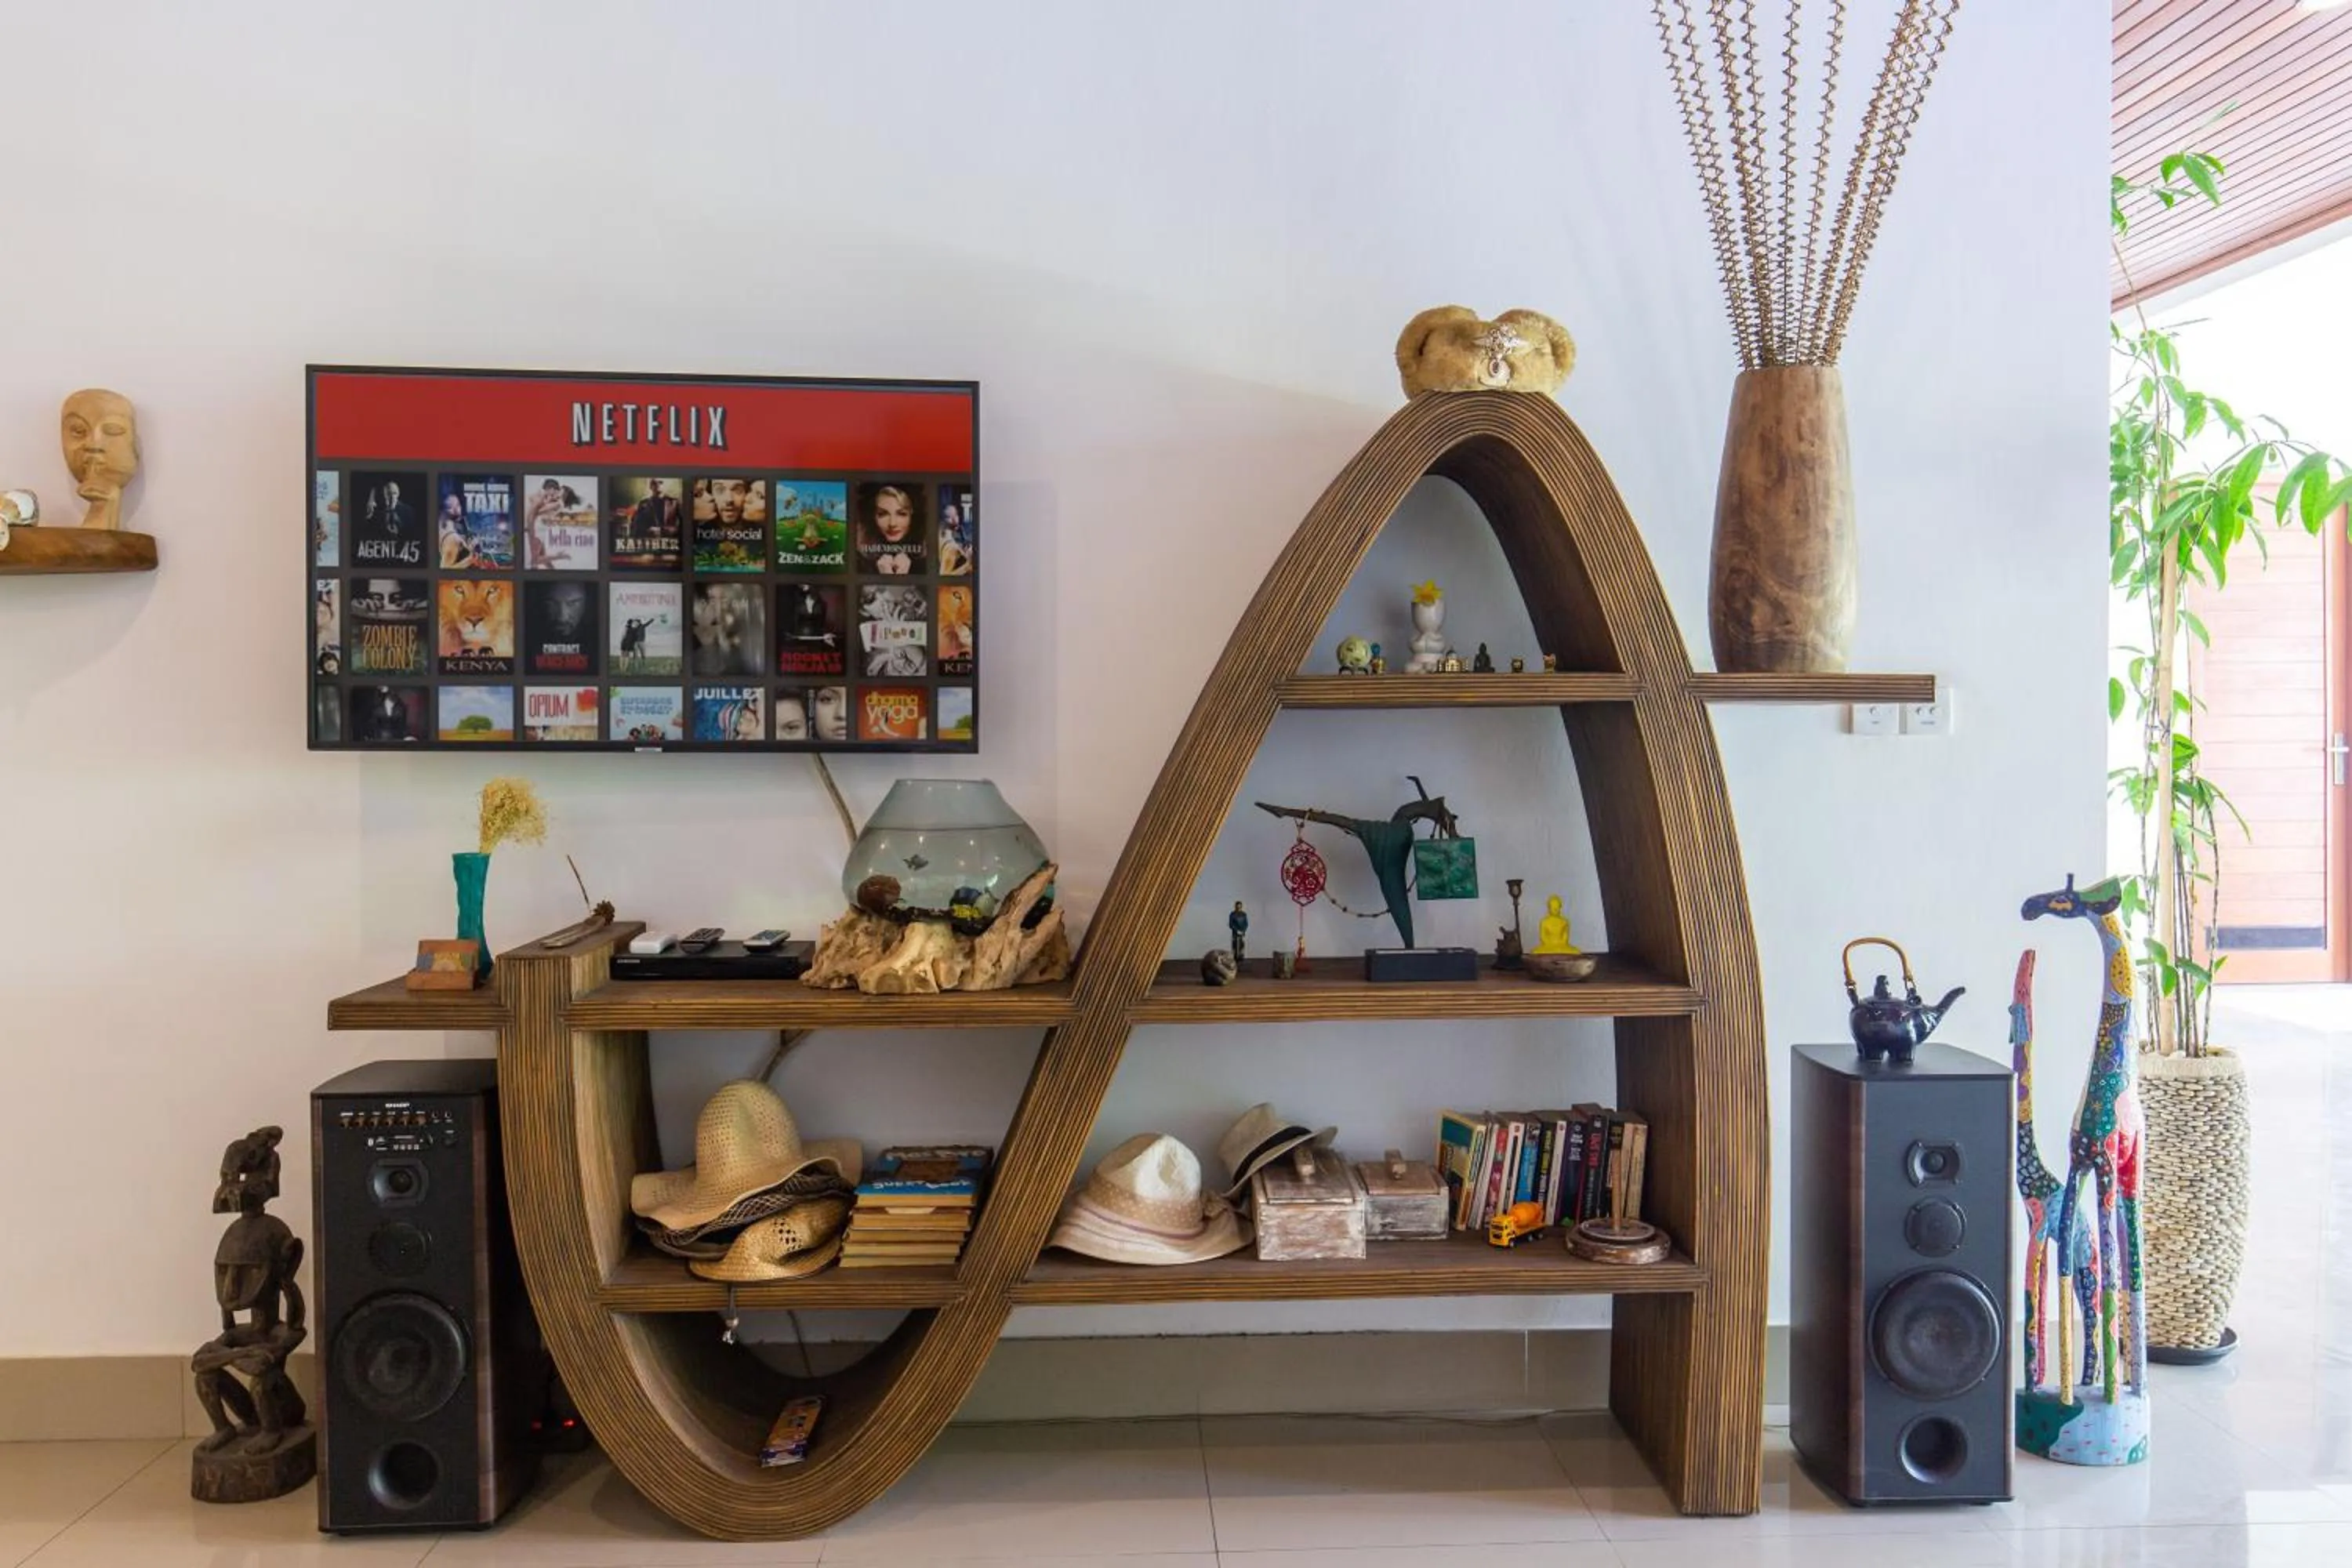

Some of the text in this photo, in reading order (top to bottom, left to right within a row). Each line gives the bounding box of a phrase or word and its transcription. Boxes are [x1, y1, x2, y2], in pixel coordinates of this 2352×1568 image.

[572, 401, 726, 448] NETFLIX
[464, 492, 510, 514] TAXI
[727, 528, 763, 540] social
[362, 625, 417, 647] ZOMBIE
[362, 645, 416, 671] COLONY
[445, 660, 508, 671] KENYA
[528, 694, 569, 717] OPIUM
[866, 704, 918, 724] yoga
